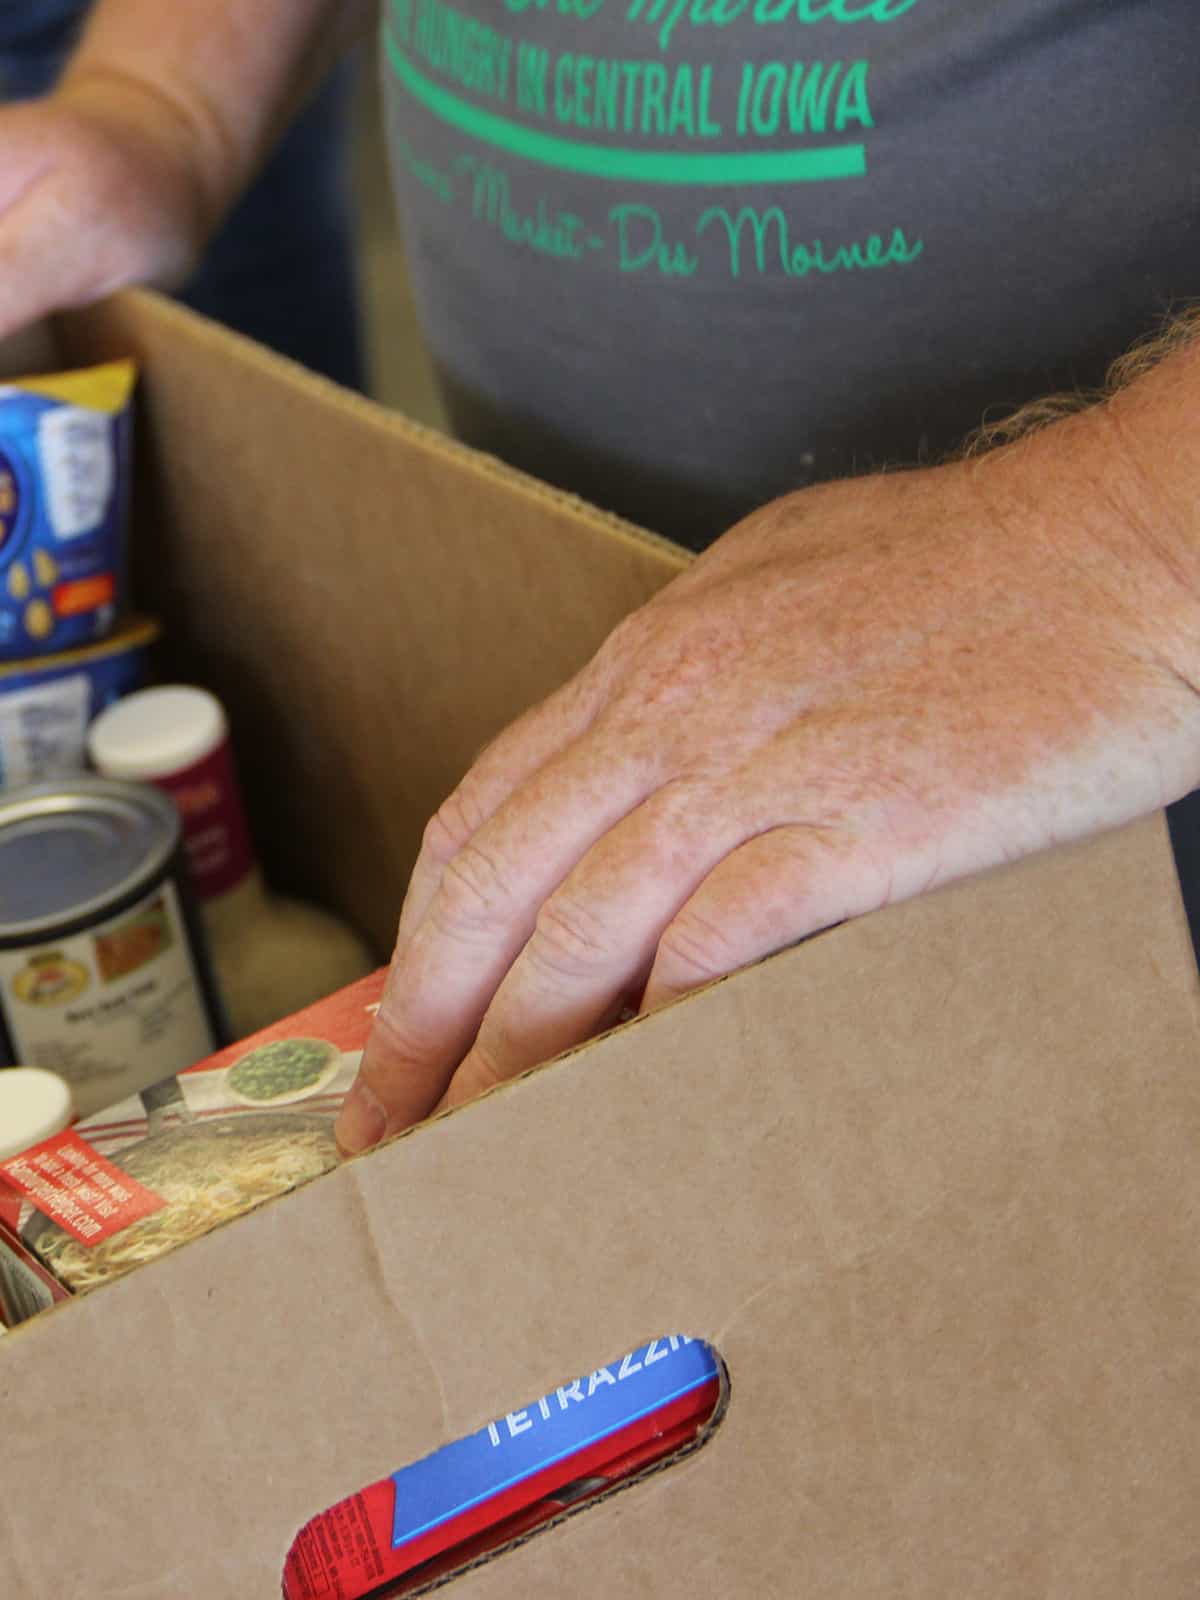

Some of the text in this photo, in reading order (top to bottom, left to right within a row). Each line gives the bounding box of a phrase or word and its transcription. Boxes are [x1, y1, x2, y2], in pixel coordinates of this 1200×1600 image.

[516, 42, 549, 117] IN
[554, 54, 722, 137] CENTRAL
[737, 60, 876, 136] IOWA
[696, 204, 925, 279] Moines
